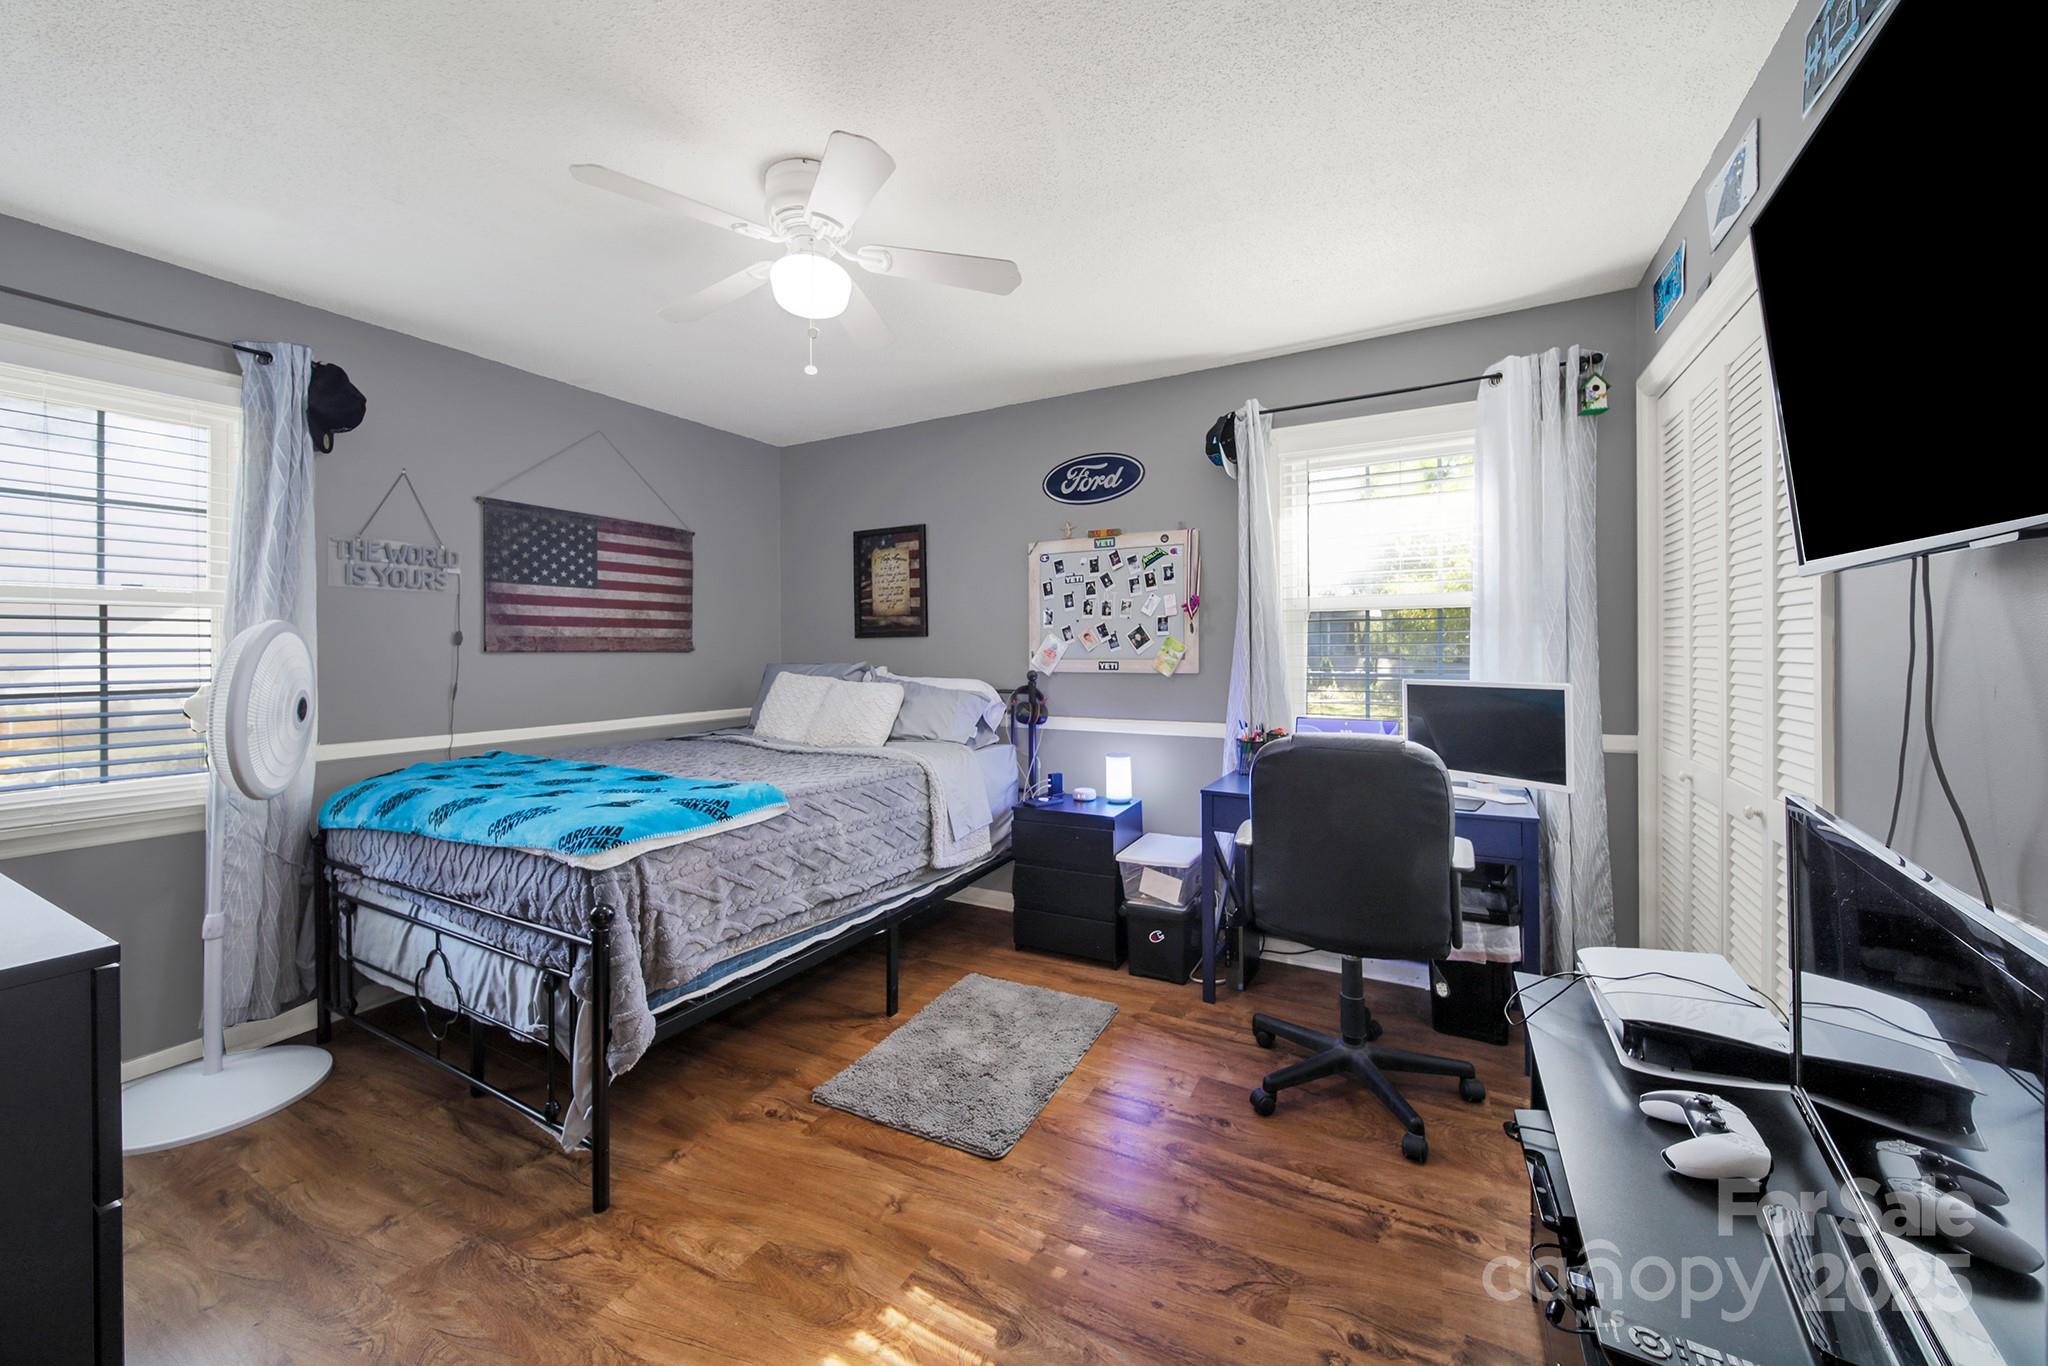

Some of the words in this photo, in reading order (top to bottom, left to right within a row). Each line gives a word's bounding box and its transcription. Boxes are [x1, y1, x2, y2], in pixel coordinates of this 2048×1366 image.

[1061, 462, 1124, 494] Ford
[330, 537, 383, 562] THE
[384, 542, 459, 569] WORLD
[1095, 538, 1115, 548] YETI
[345, 563, 367, 586] IS
[370, 565, 448, 591] YOURS
[1065, 575, 1083, 584] YETI
[1099, 662, 1118, 670] YETI
[558, 825, 625, 850] CAROLINA
